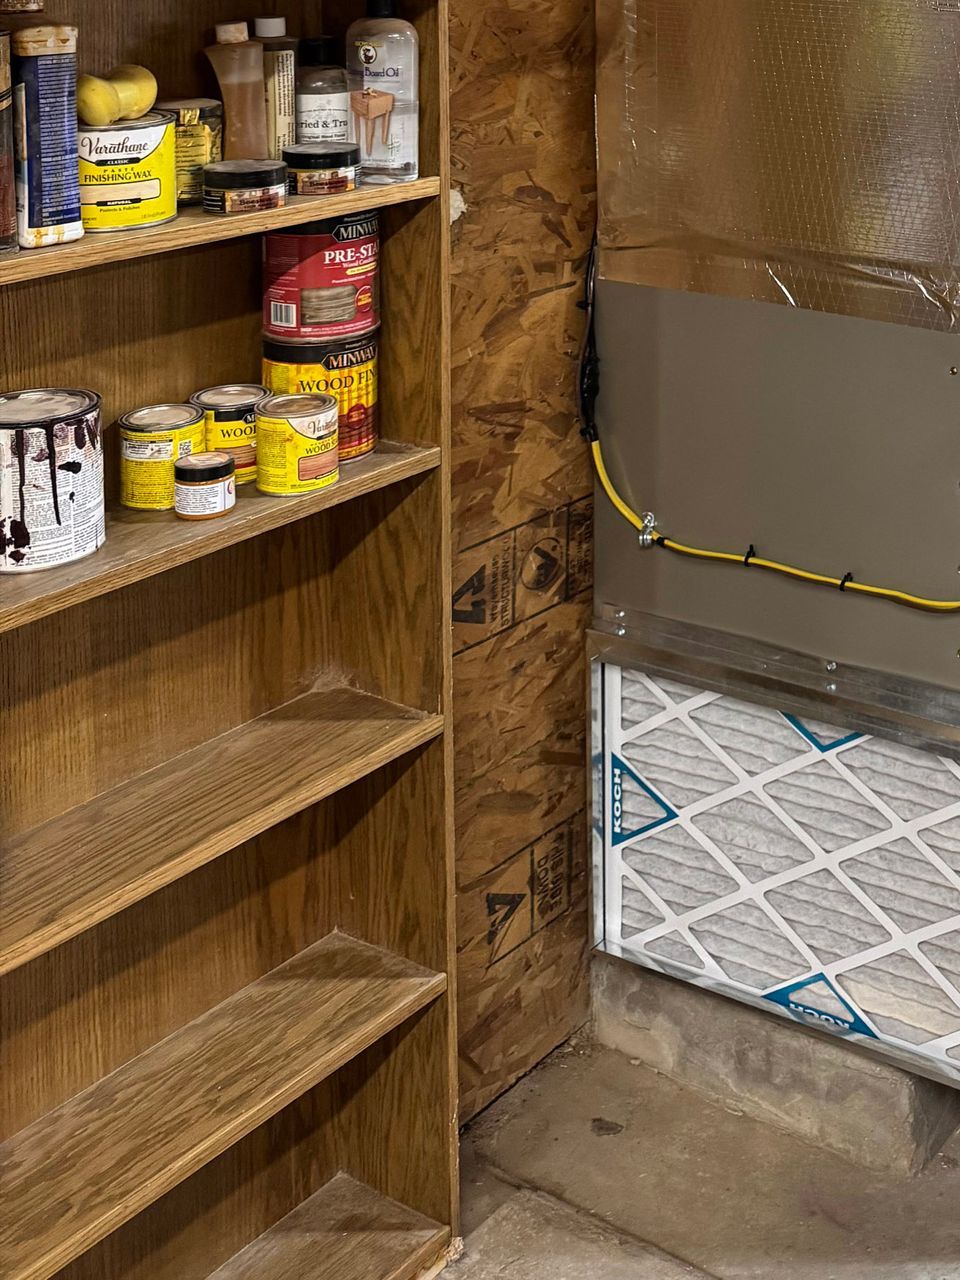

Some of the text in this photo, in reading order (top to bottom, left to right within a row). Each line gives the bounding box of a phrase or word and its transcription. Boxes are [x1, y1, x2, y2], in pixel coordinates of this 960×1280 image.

[364, 67, 385, 77] Board
[299, 118, 348, 129] ried & Tru
[81, 136, 149, 157] Varathane
[84, 169, 153, 183] FINISHING WAX
[299, 375, 355, 393] WOOD
[305, 441, 332, 455] WOOD
[613, 768, 622, 834] KOCH
